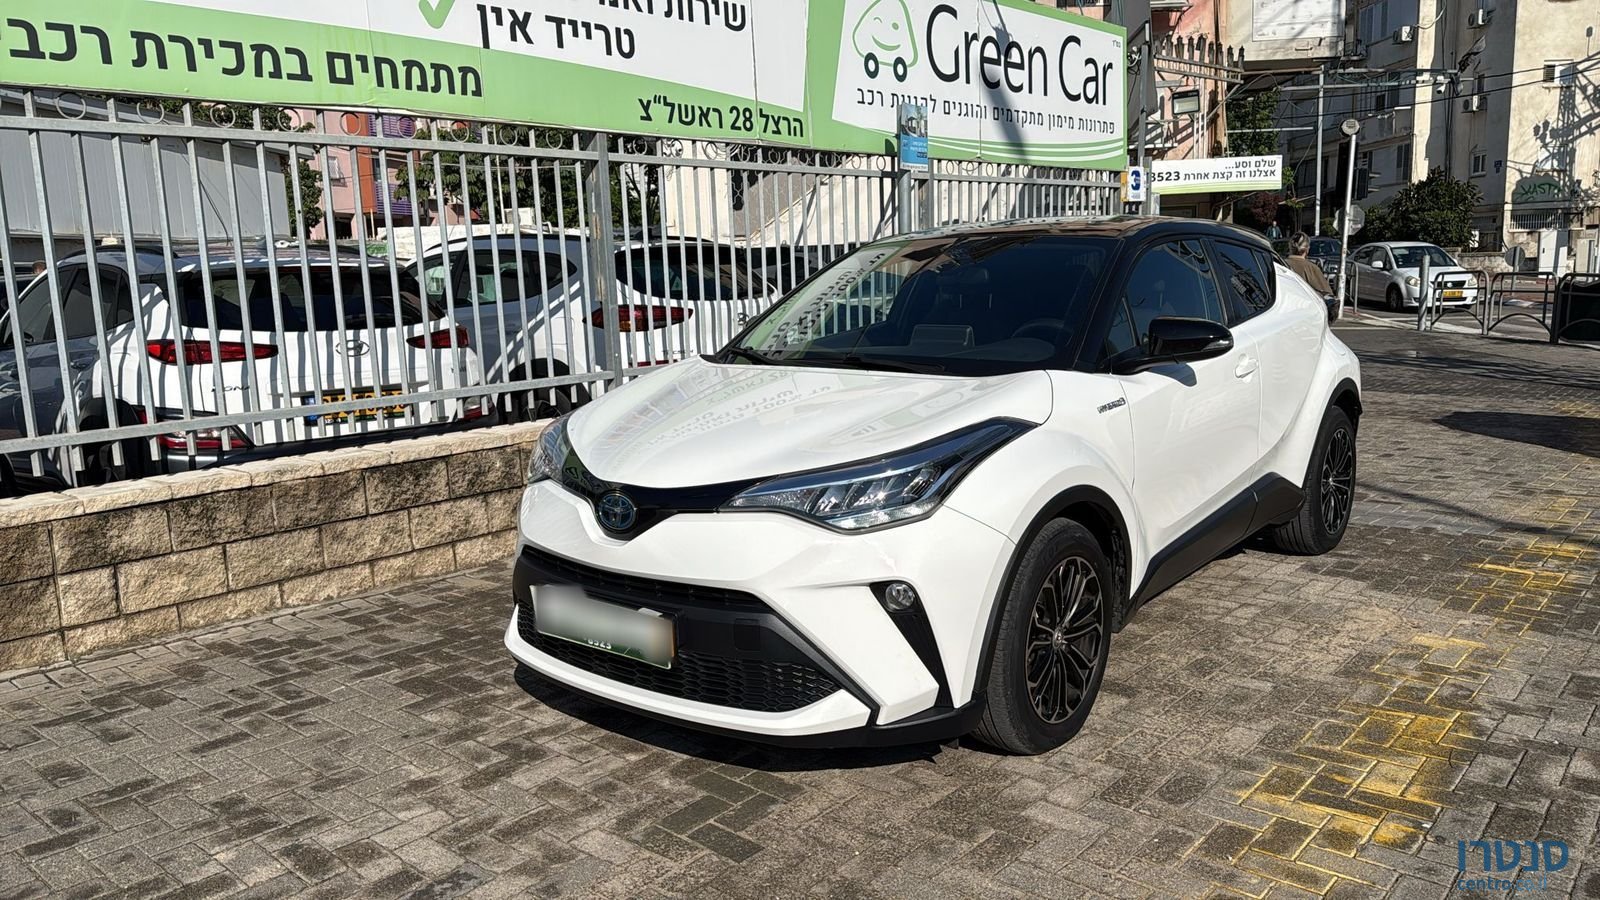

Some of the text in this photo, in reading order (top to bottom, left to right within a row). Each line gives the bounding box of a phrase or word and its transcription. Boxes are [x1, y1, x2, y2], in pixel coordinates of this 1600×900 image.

[477, 4, 636, 59] טרייד אין
[0, 18, 482, 97] מתמחים במכירת רכב
[926, 4, 1113, 106] Green Car
[857, 88, 884, 107] רכב
[729, 105, 754, 132] 28
[943, 100, 987, 119] והוגנים
[993, 106, 1044, 128] מתקדמים
[759, 108, 804, 138] הרצל
[1048, 113, 1075, 131] מימון
[1078, 117, 1115, 134] פתרונות
[1254, 158, 1276, 168] שלם
[1183, 172, 1210, 181] אחרת
[1212, 171, 1233, 181] קצת
[1249, 169, 1276, 177] אצלנו
